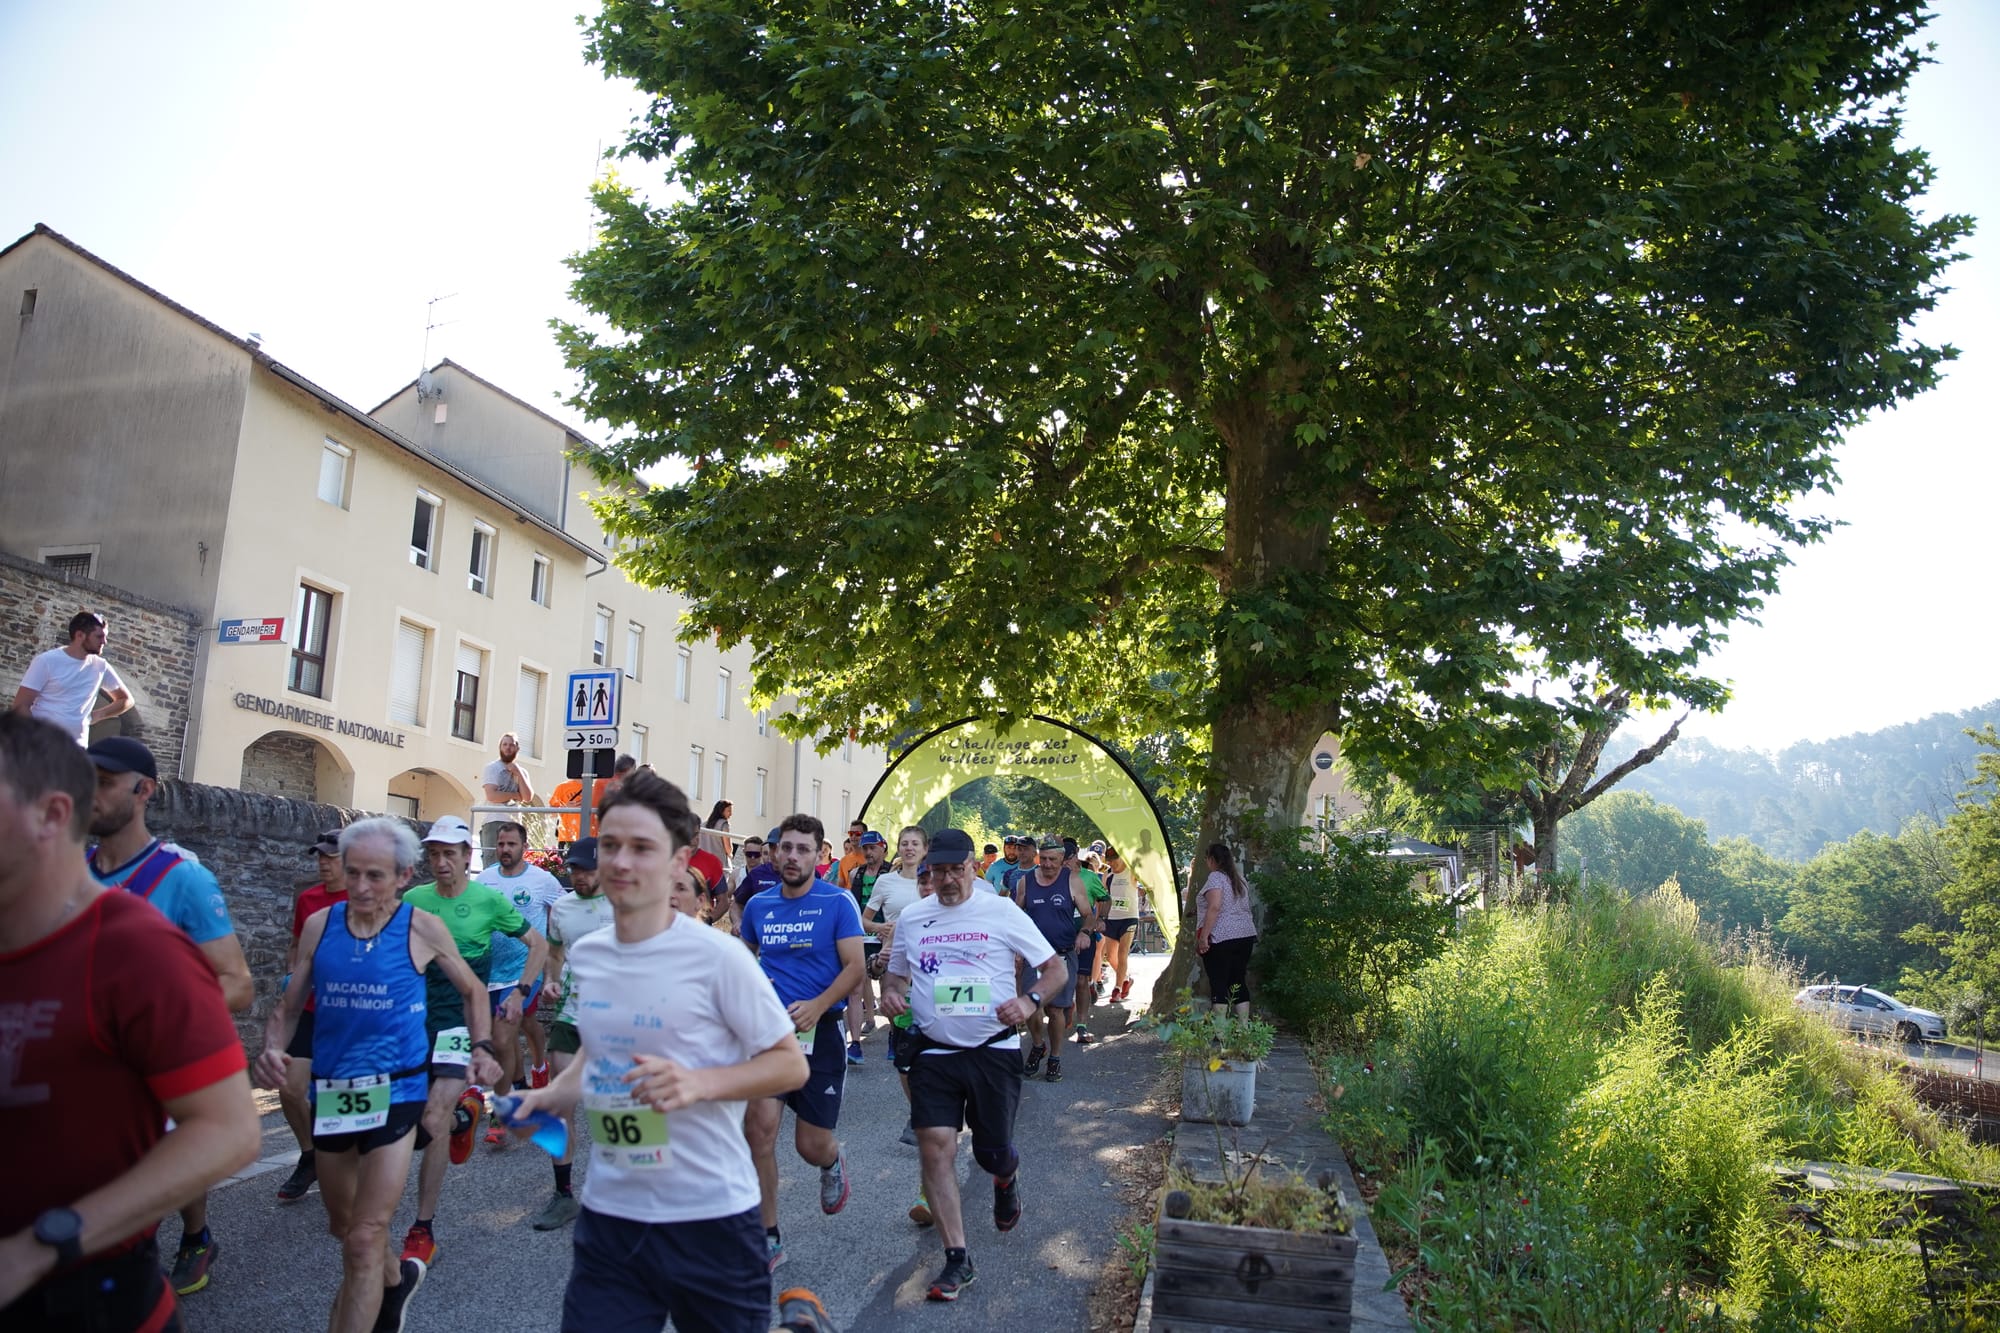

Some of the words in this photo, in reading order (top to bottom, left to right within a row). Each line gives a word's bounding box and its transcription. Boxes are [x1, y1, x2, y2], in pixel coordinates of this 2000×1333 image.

[227, 625, 276, 637] GENDARMERIE
[234, 692, 335, 731] GENDARMERIE
[338, 719, 406, 749] NATIONALE
[949, 737, 1031, 755] Challenge
[1041, 738, 1069, 750] des
[939, 752, 996, 765] vallées
[763, 922, 815, 934] warsaw
[762, 935, 788, 945] runs
[949, 986, 974, 1003] 71
[337, 1091, 371, 1115] 35
[601, 1114, 642, 1145] 96
